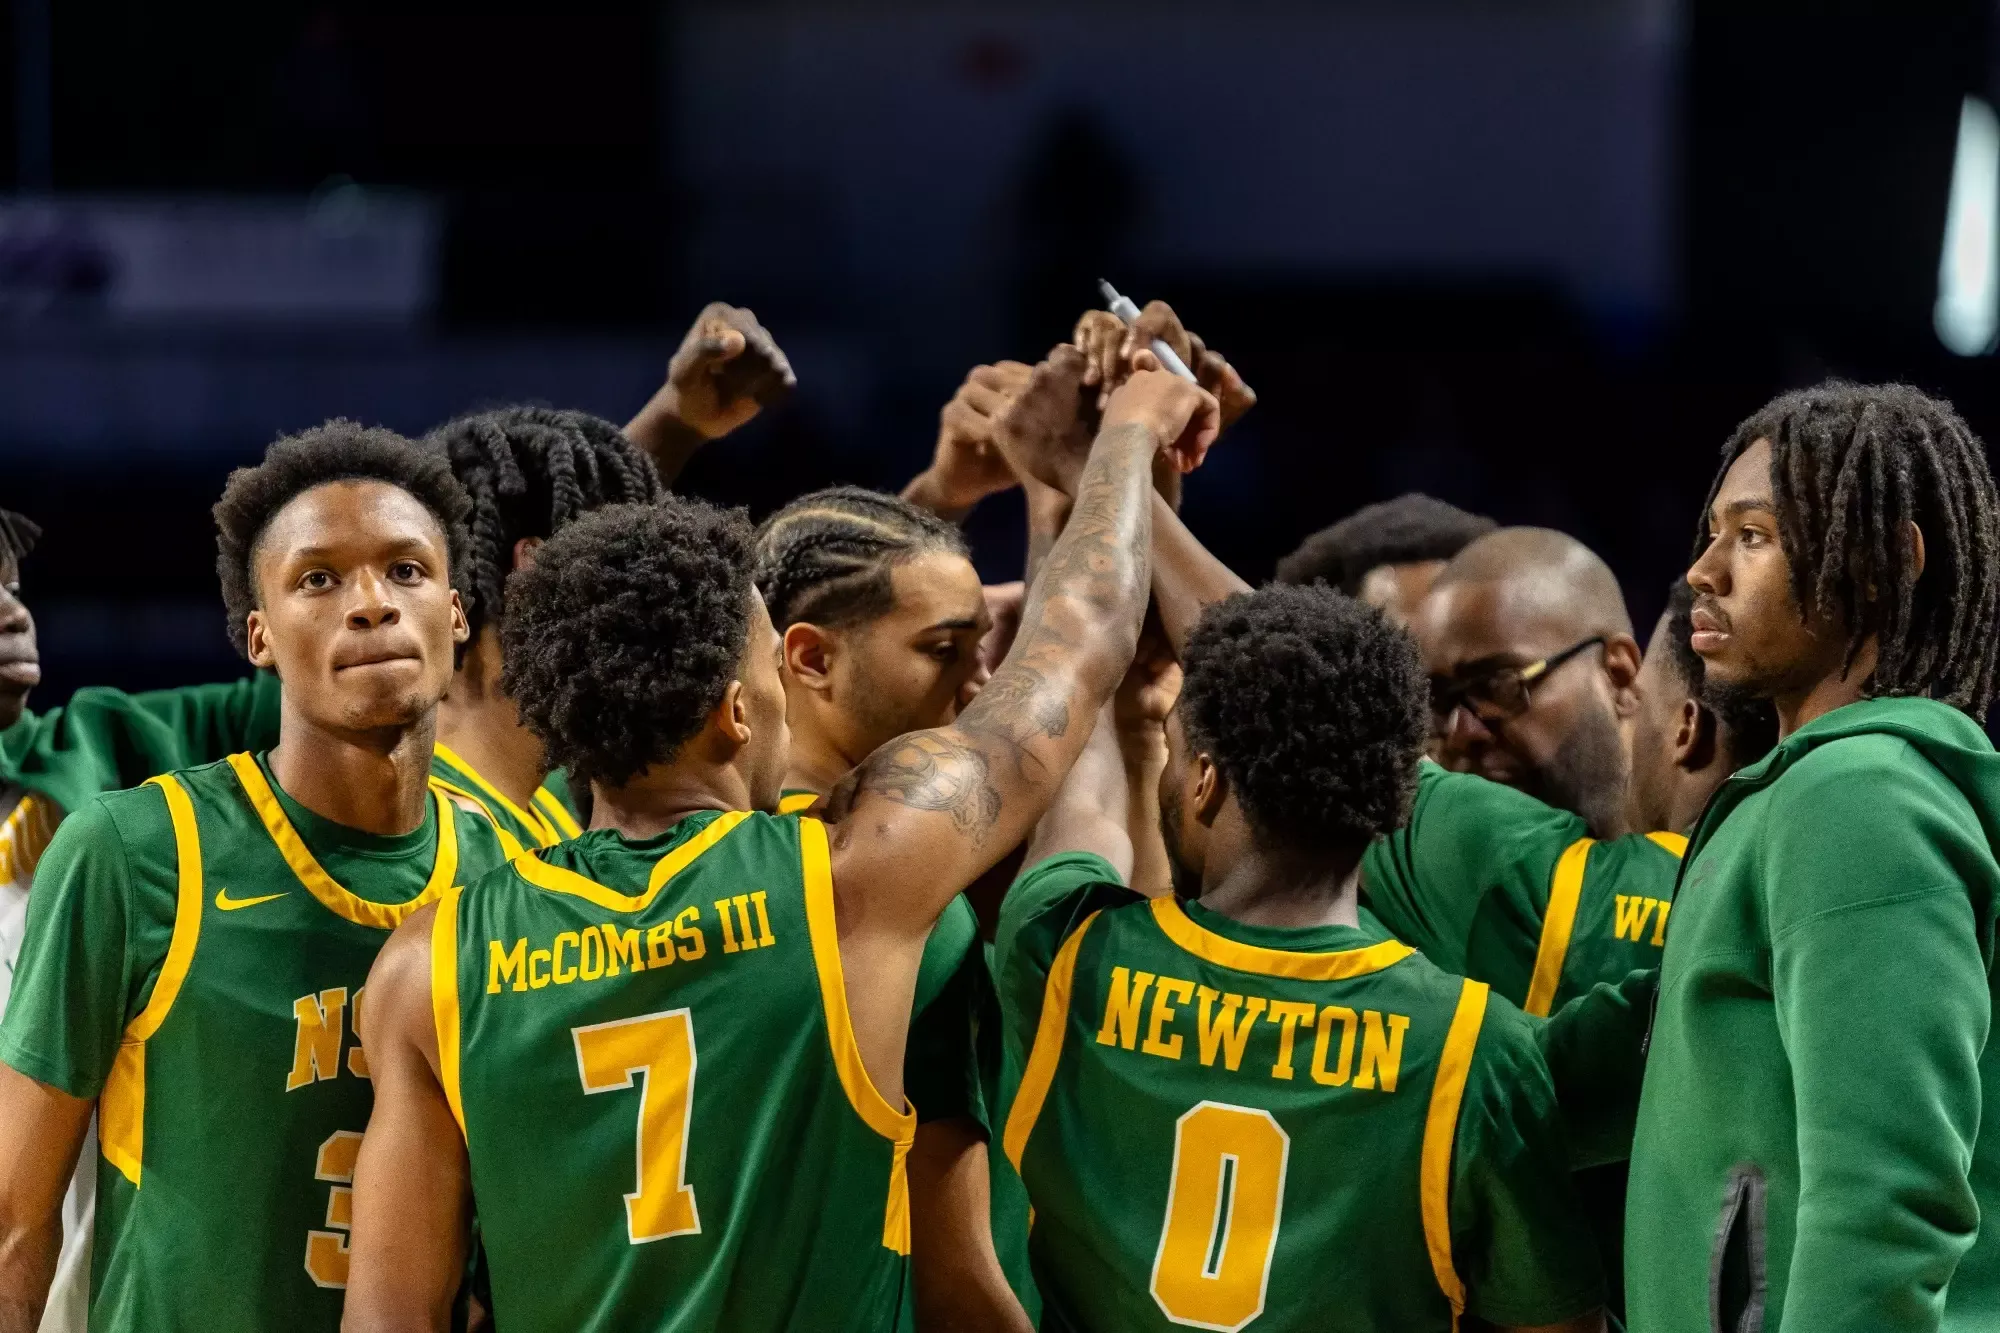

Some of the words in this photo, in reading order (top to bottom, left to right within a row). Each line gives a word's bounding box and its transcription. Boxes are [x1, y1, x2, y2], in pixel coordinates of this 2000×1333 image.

[486, 903, 707, 995] McCOMBS
[713, 890, 776, 954] III
[1096, 966, 1410, 1093] NEWTON
[571, 1007, 702, 1245] 7
[1149, 1100, 1291, 1333] 0
